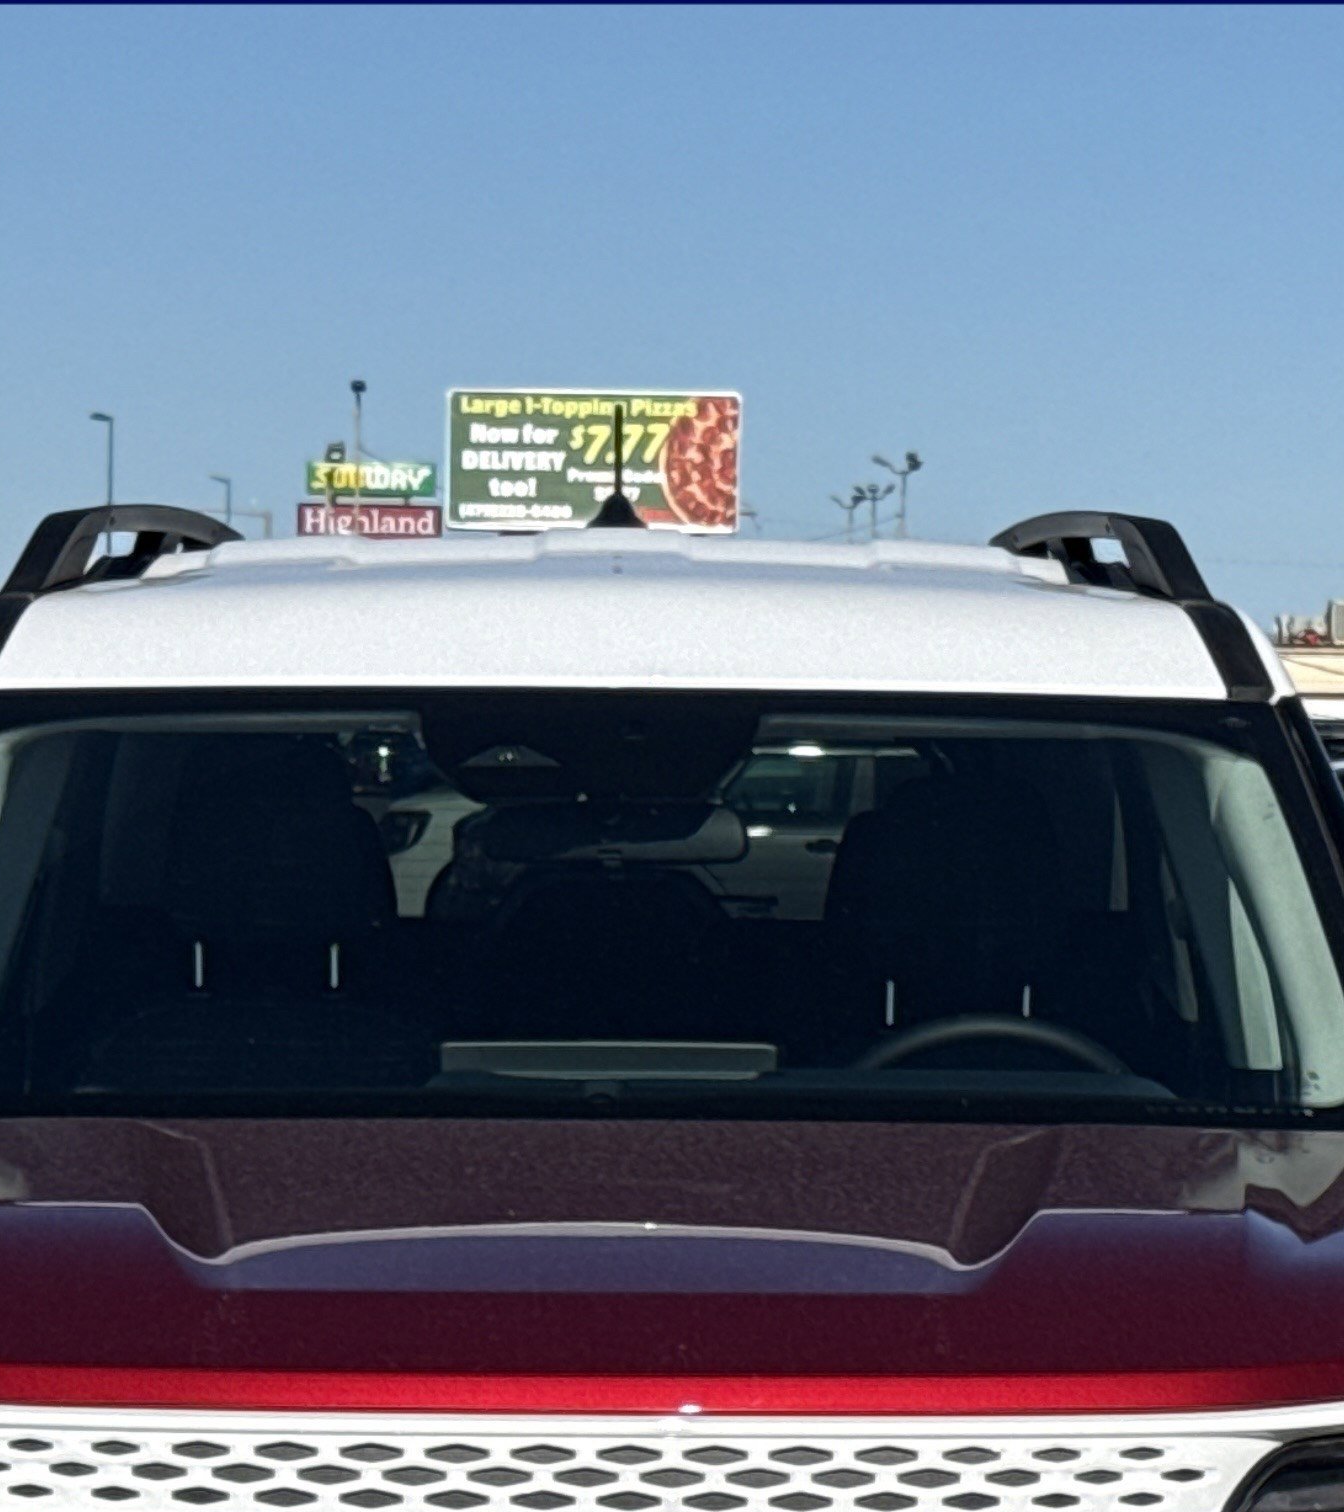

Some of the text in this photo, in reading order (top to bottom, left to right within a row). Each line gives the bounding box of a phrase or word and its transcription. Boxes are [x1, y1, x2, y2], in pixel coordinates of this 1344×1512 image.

[460, 396, 521, 418] Large
[630, 398, 697, 418] Pizzas
[469, 422, 559, 444] Now for
[461, 449, 567, 471] DELIVERY
[309, 463, 432, 490] SUBWAY
[487, 477, 538, 498] too!
[303, 507, 437, 536] Highland
